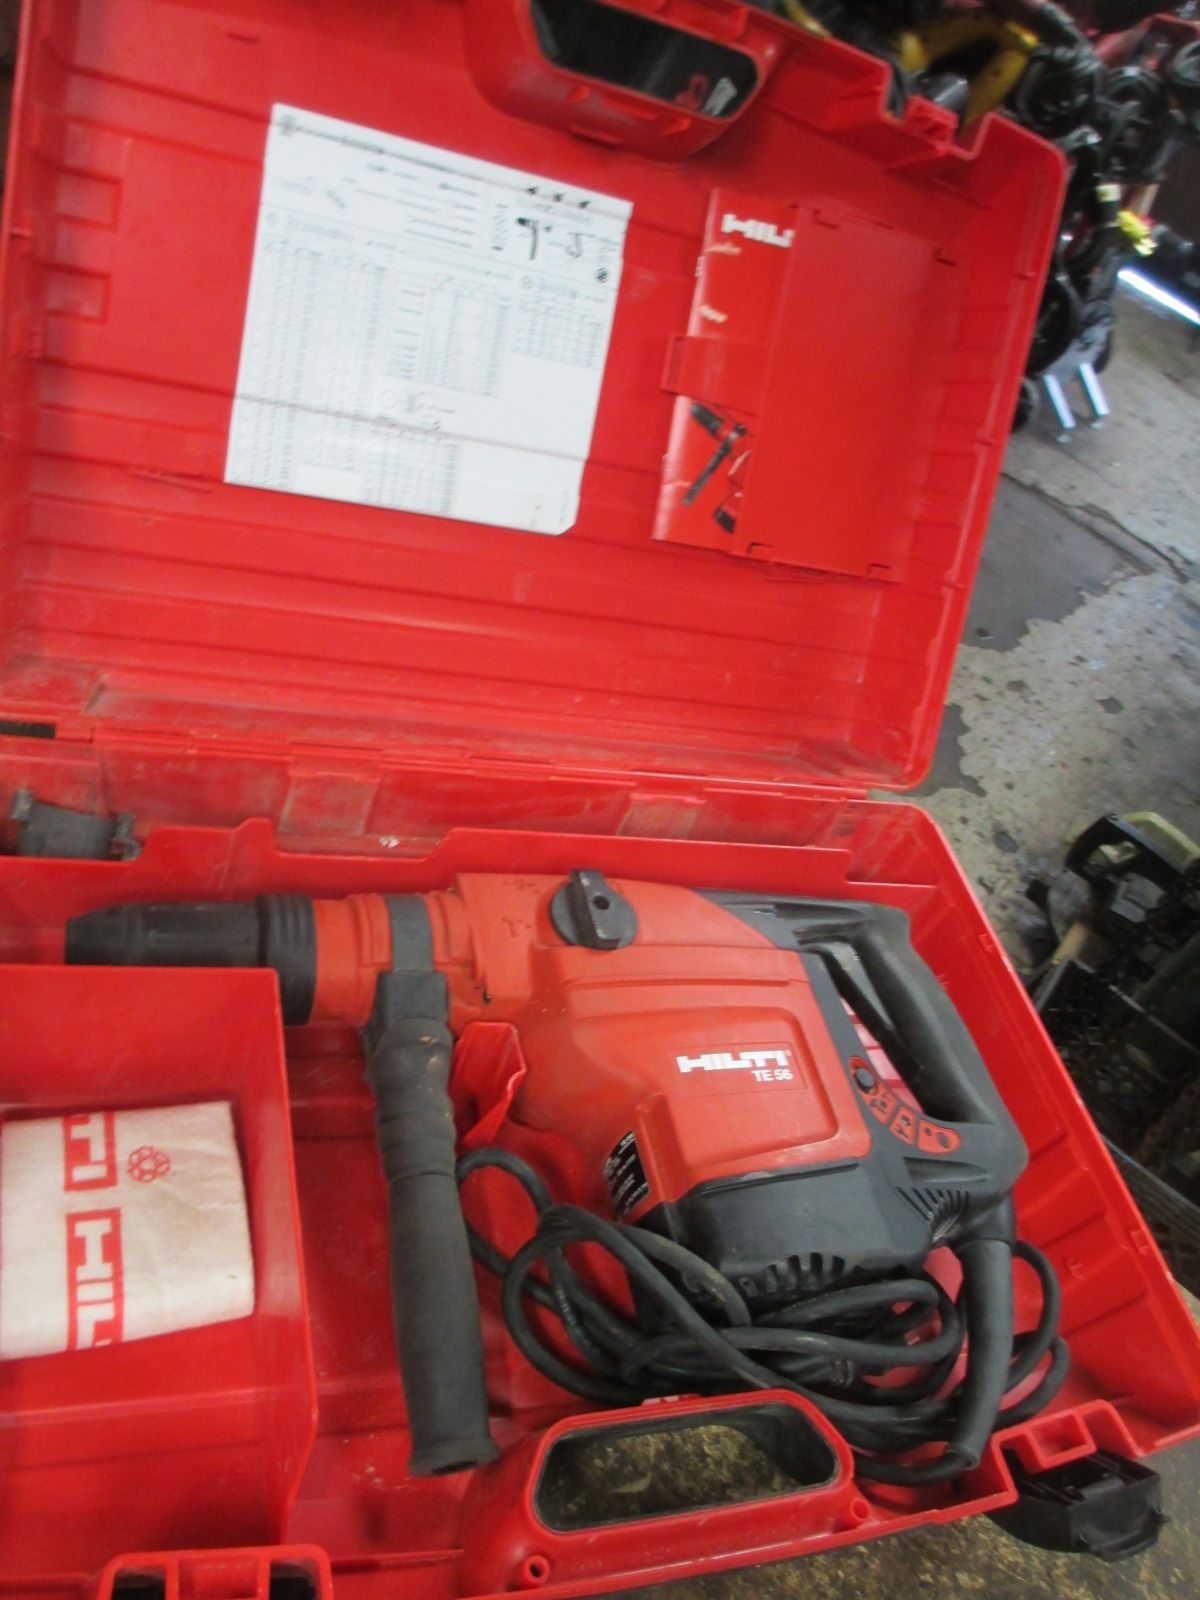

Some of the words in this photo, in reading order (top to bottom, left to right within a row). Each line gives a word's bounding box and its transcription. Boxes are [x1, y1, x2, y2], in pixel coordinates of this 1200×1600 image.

[676, 1051, 788, 1073] HILTI
[751, 1069, 774, 1082] TE
[75, 1218, 115, 1349] HIL
